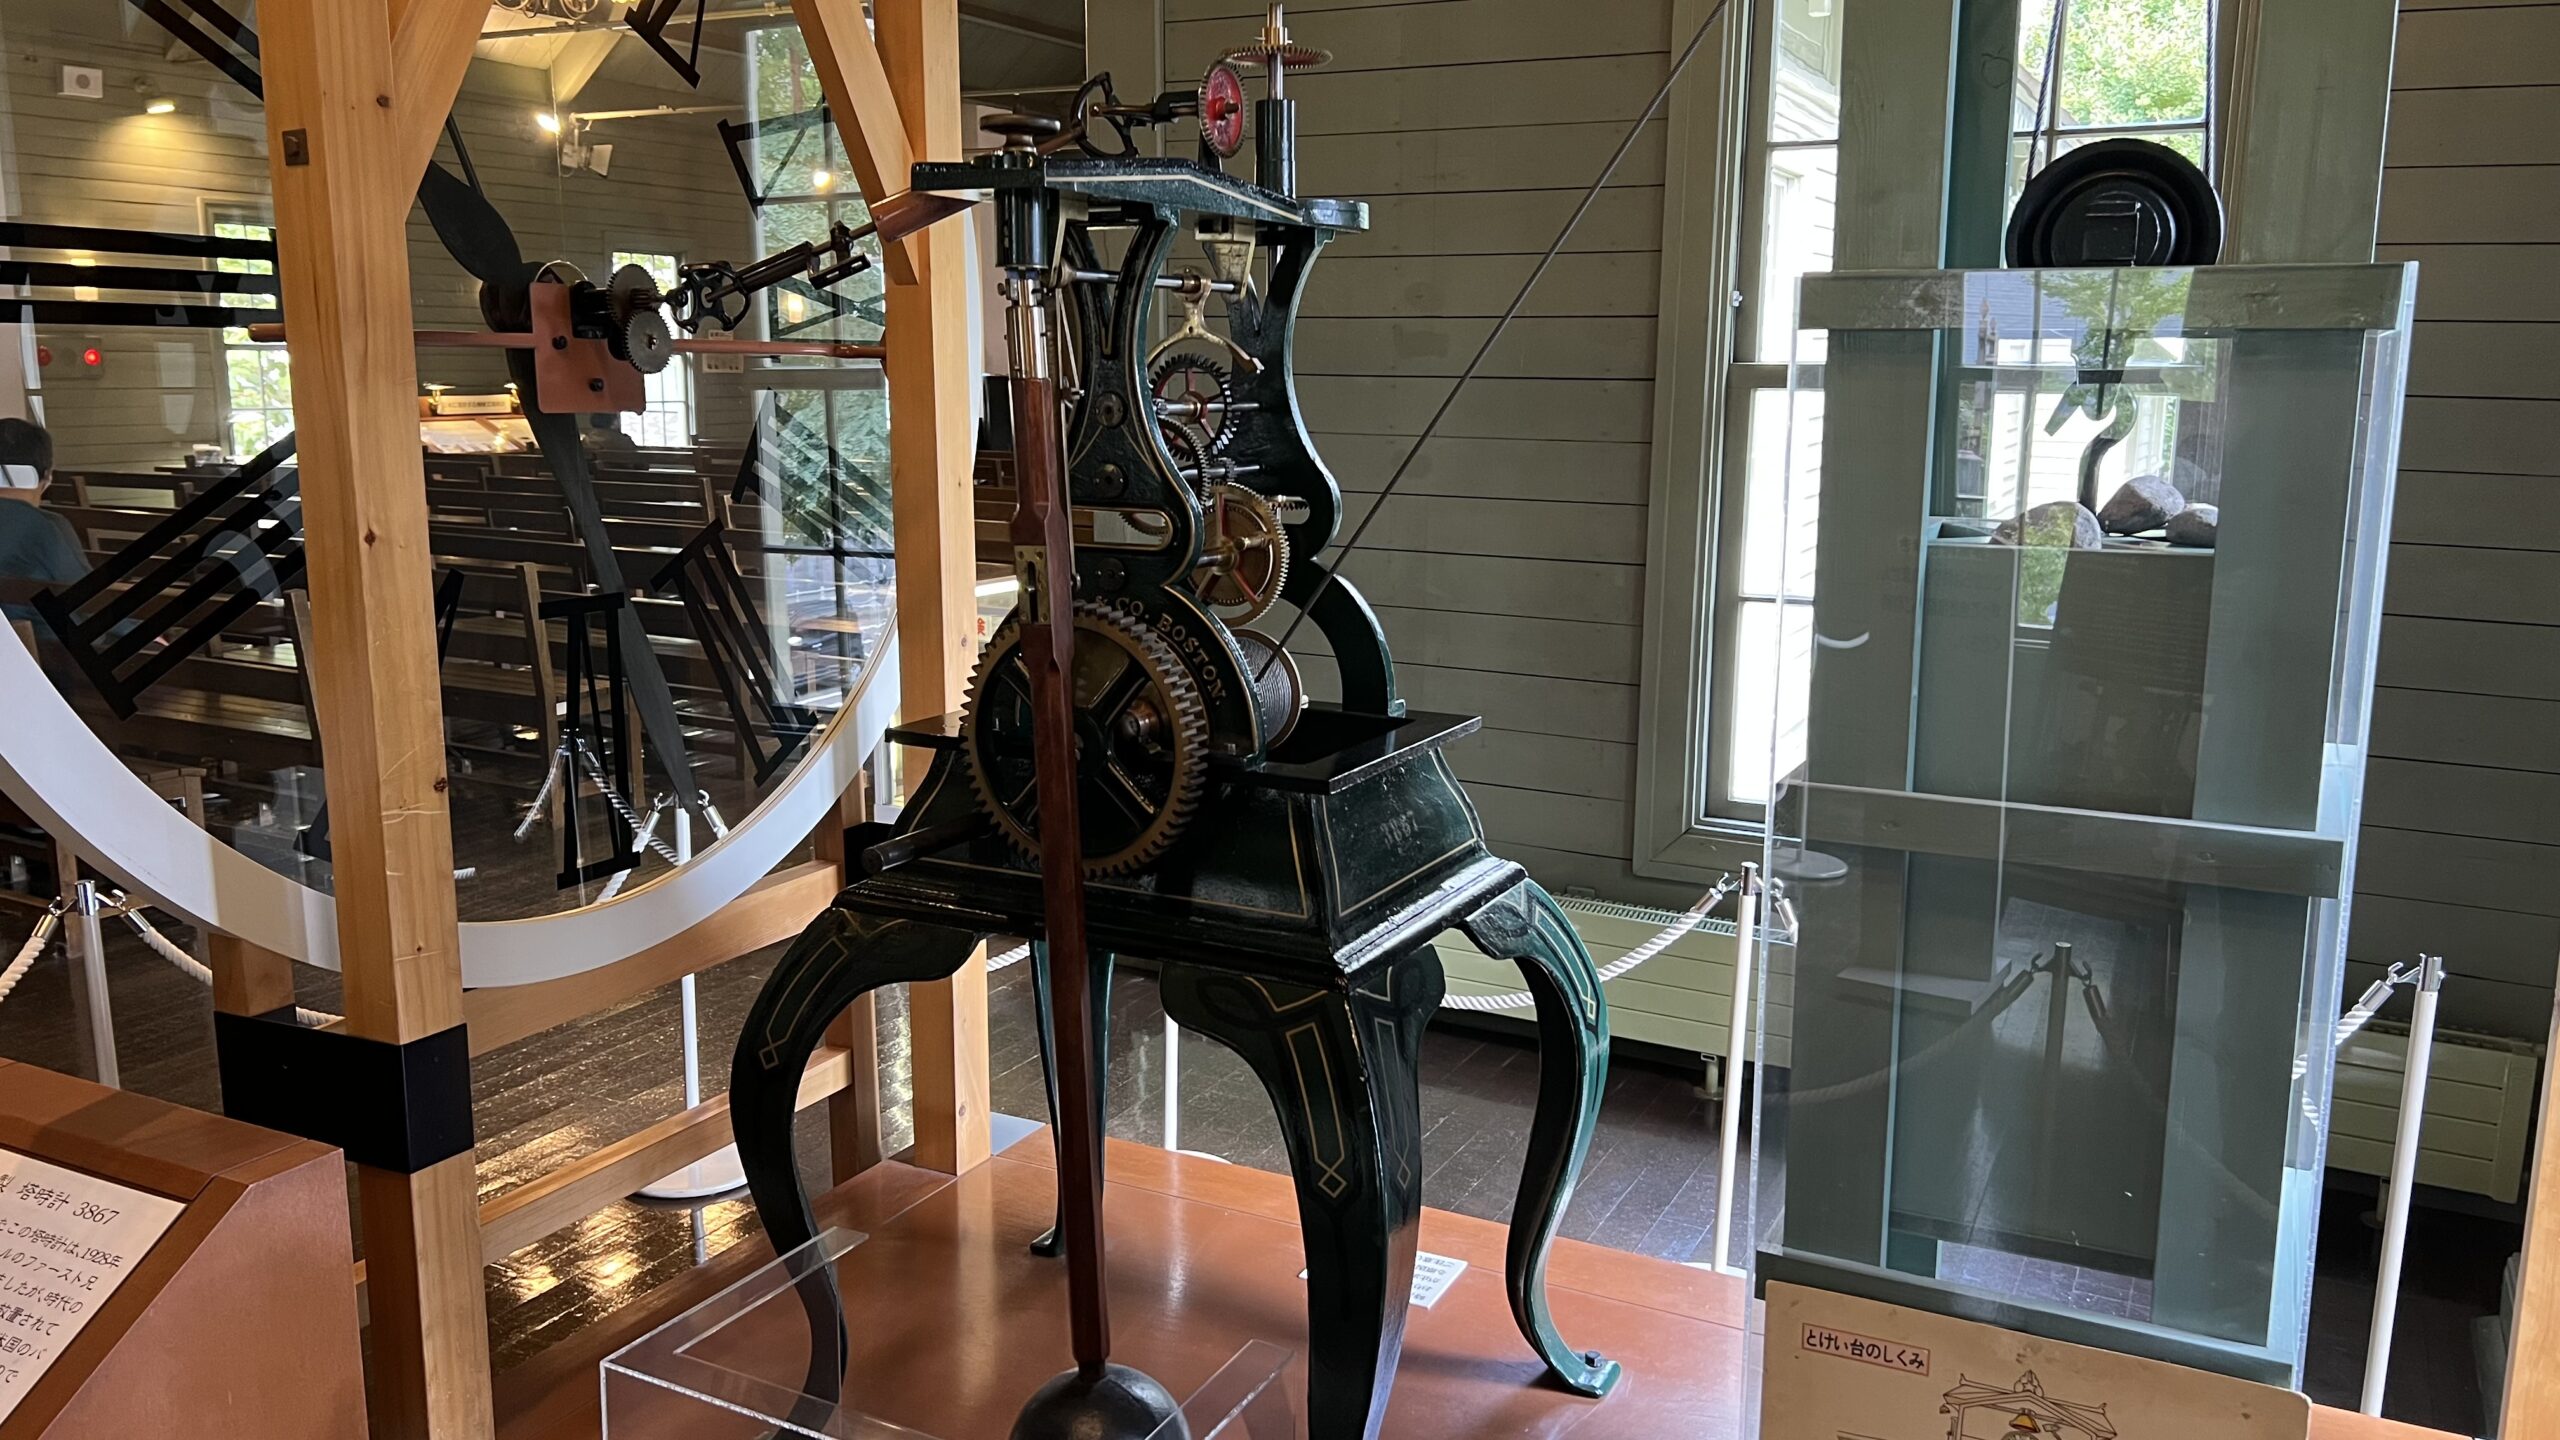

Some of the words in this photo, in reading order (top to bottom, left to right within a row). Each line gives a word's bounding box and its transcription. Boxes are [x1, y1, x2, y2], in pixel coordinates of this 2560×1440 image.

[1115, 597, 1151, 620] CO.
[1156, 612, 1227, 706] BOSTON.
[16, 1181, 71, 1211] 塔時計
[72, 1201, 120, 1225] 3867
[1806, 1329, 1925, 1369] とけい台のしくみ
